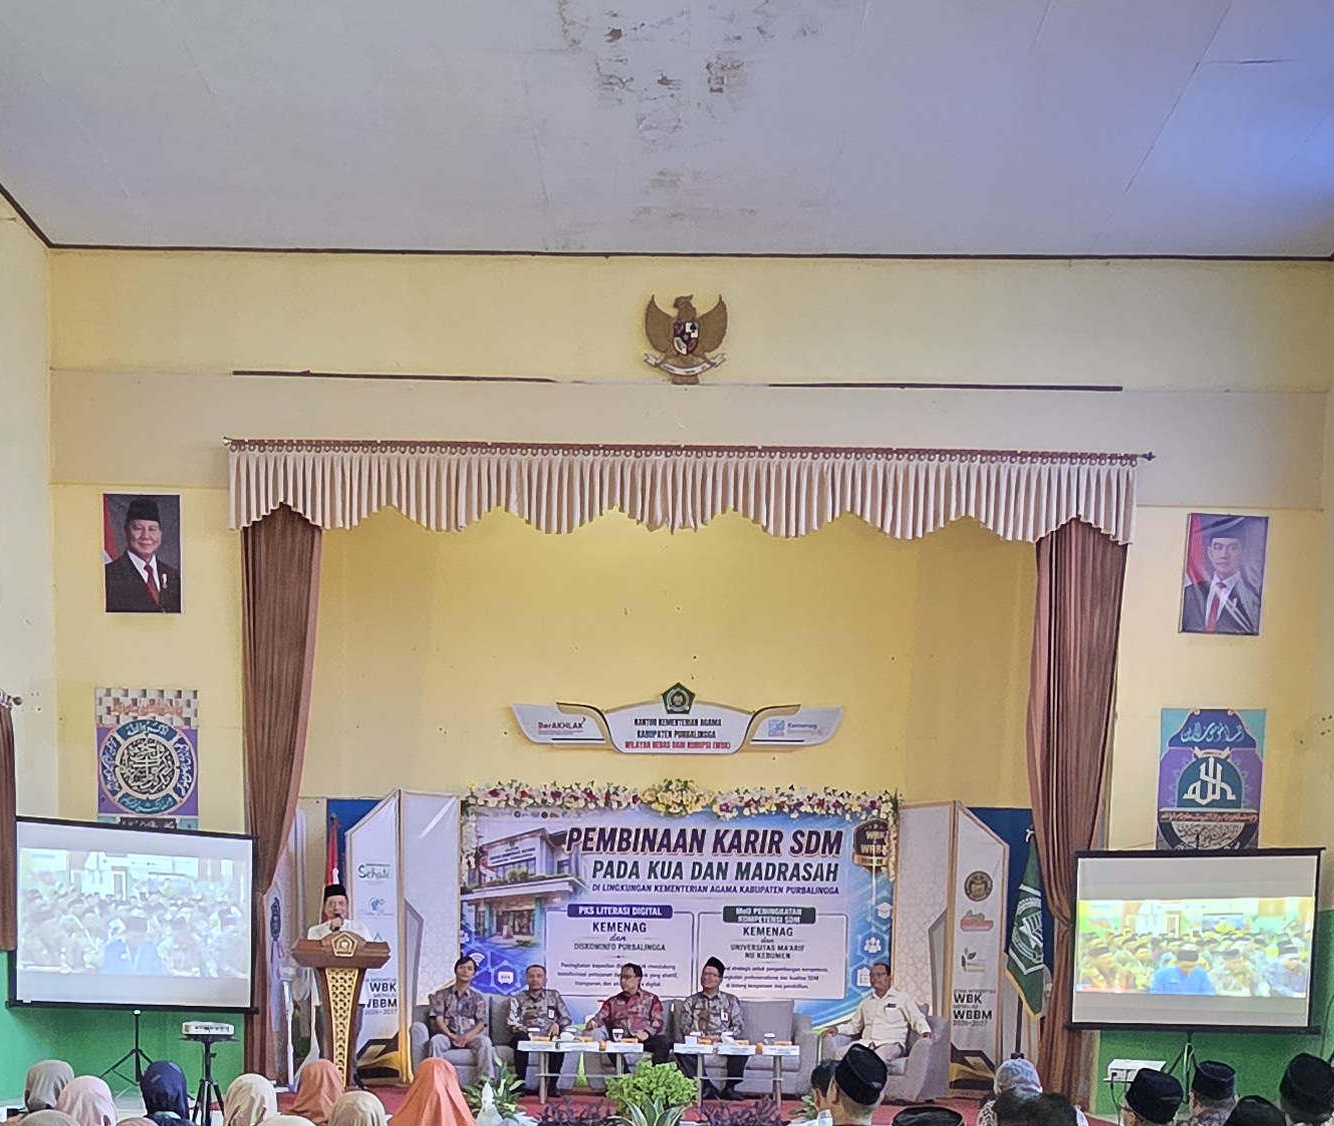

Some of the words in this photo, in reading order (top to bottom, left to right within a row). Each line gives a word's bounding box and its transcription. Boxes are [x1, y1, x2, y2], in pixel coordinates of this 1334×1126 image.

[565, 827, 706, 855] PEMBINAAN
[712, 829, 784, 856] KARIR
[789, 830, 844, 857] SDM
[592, 860, 640, 880] PADA
[647, 860, 684, 880] KUA
[690, 861, 729, 881] DAN
[734, 862, 839, 882] MADRASAH
[592, 883, 601, 892] DI
[602, 883, 652, 893] LINGKUNGAN
[653, 884, 708, 894] KEMENTERIAN
[709, 885, 738, 894] AGAMA
[739, 885, 784, 894] KABUPATEN
[786, 886, 839, 895] PURBALINGGA
[578, 906, 595, 915] PKS
[596, 906, 630, 915] LITERASI
[632, 907, 662, 916] DIGITAL
[592, 922, 647, 933] KEMENAG
[742, 926, 794, 937] KEMENAG
[609, 933, 626, 941] dan
[573, 943, 616, 951] DISKOMINFO
[618, 943, 666, 951] PURBALINGGA
[369, 982, 397, 992] WBK
[954, 993, 983, 1004] WBK
[953, 1010, 993, 1020] WBBM
